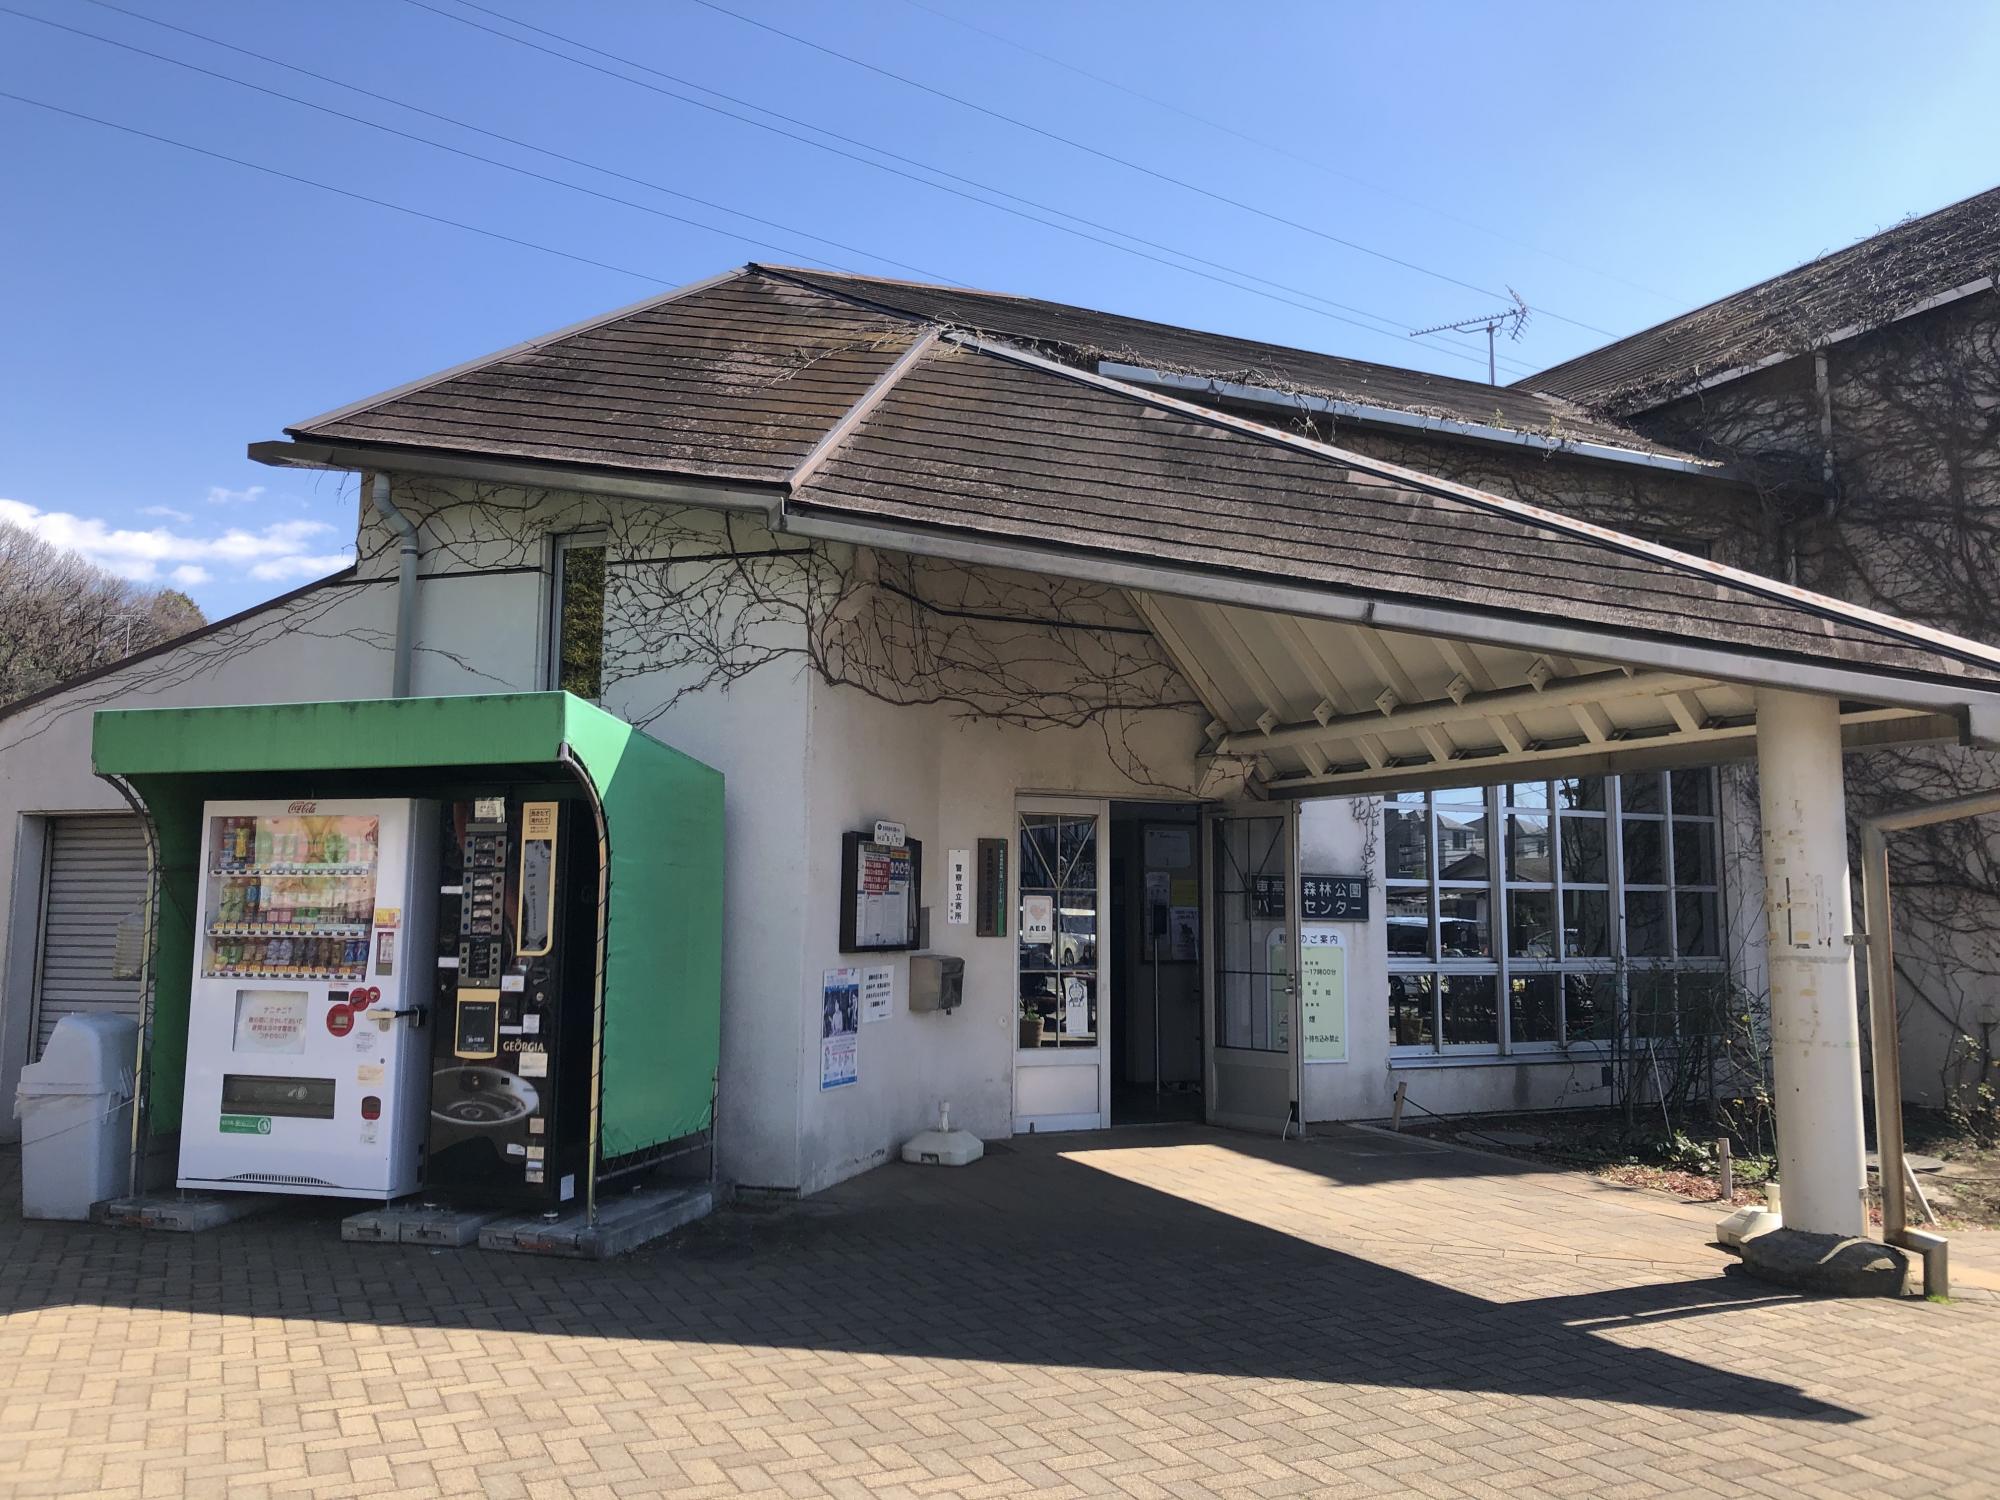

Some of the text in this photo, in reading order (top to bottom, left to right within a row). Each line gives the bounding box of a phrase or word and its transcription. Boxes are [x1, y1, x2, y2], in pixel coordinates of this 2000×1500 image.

[954, 864, 963, 921] 警察官立寄所
[503, 1039, 544, 1052] GEORGIA
